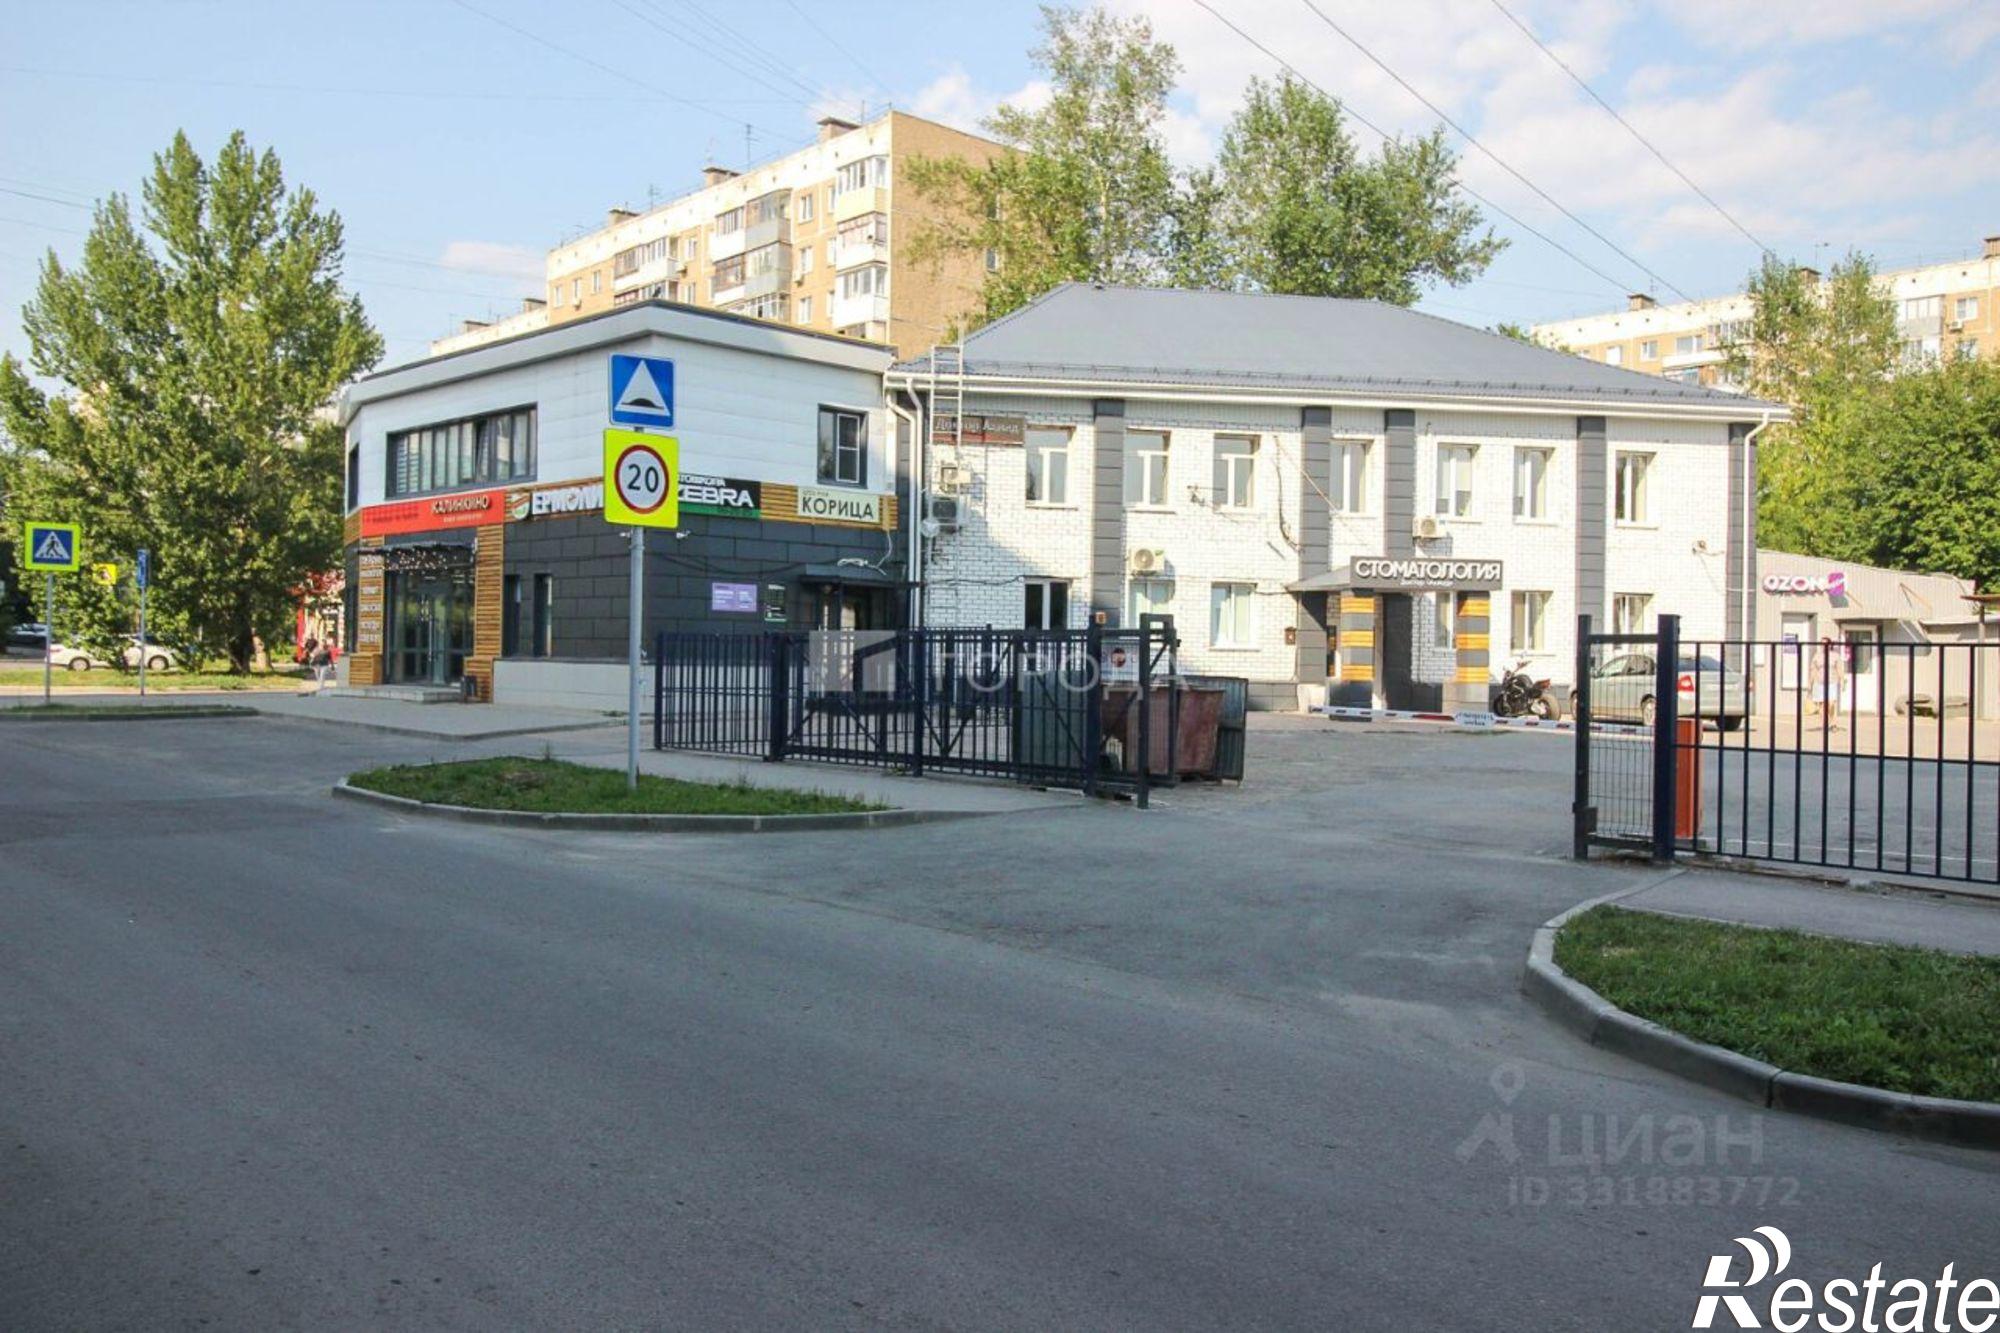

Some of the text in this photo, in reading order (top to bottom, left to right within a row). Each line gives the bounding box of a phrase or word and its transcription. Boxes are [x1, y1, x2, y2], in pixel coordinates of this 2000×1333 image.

[627, 463, 660, 493] 20
[532, 484, 604, 515] ЕРМОЛИ
[802, 496, 874, 519] КОРИЦА
[1355, 559, 1501, 580] СТОМАТОЛОГИЯ
[1763, 575, 1827, 593] OZON
